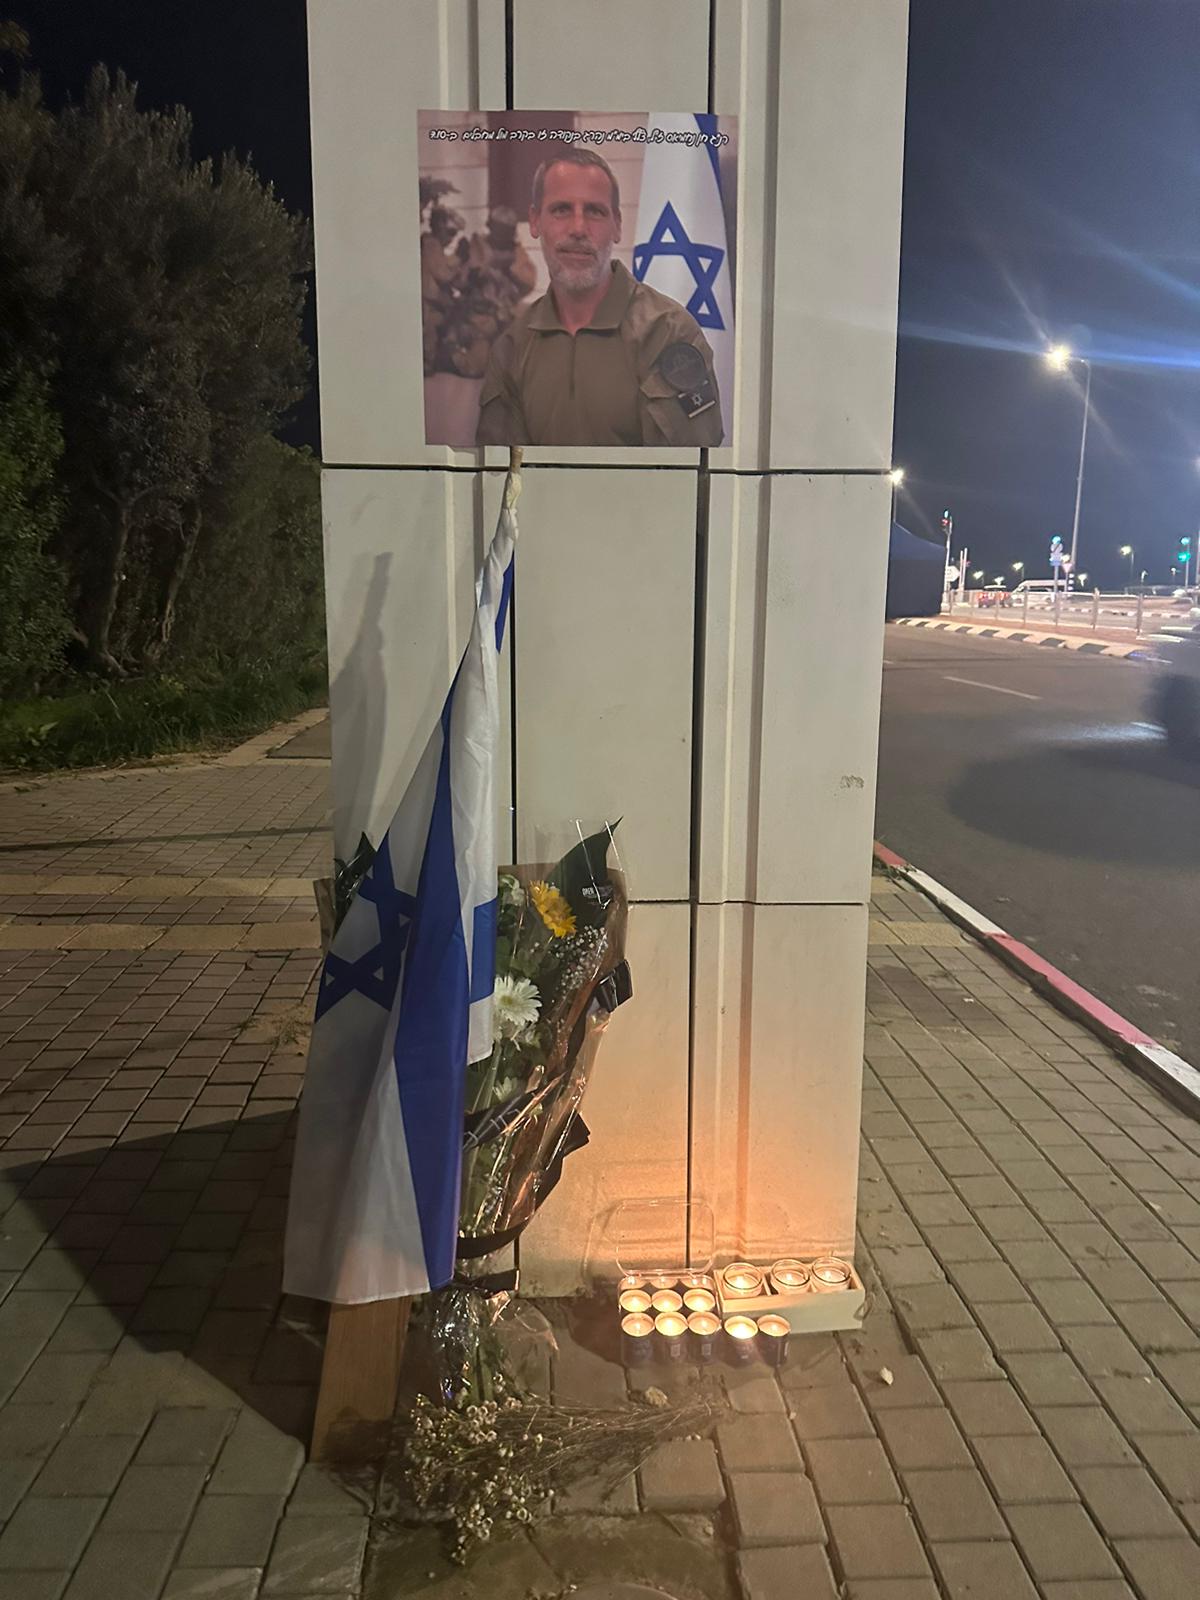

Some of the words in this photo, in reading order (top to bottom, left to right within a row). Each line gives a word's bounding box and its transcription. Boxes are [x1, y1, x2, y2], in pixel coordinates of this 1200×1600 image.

[462, 126, 494, 141] מחבלים
[495, 126, 508, 140] מול
[509, 129, 535, 142] בקרב
[537, 129, 547, 141] זו
[549, 129, 581, 144] בנקודה
[582, 130, 605, 144] נהרג
[696, 132, 709, 147] חן
